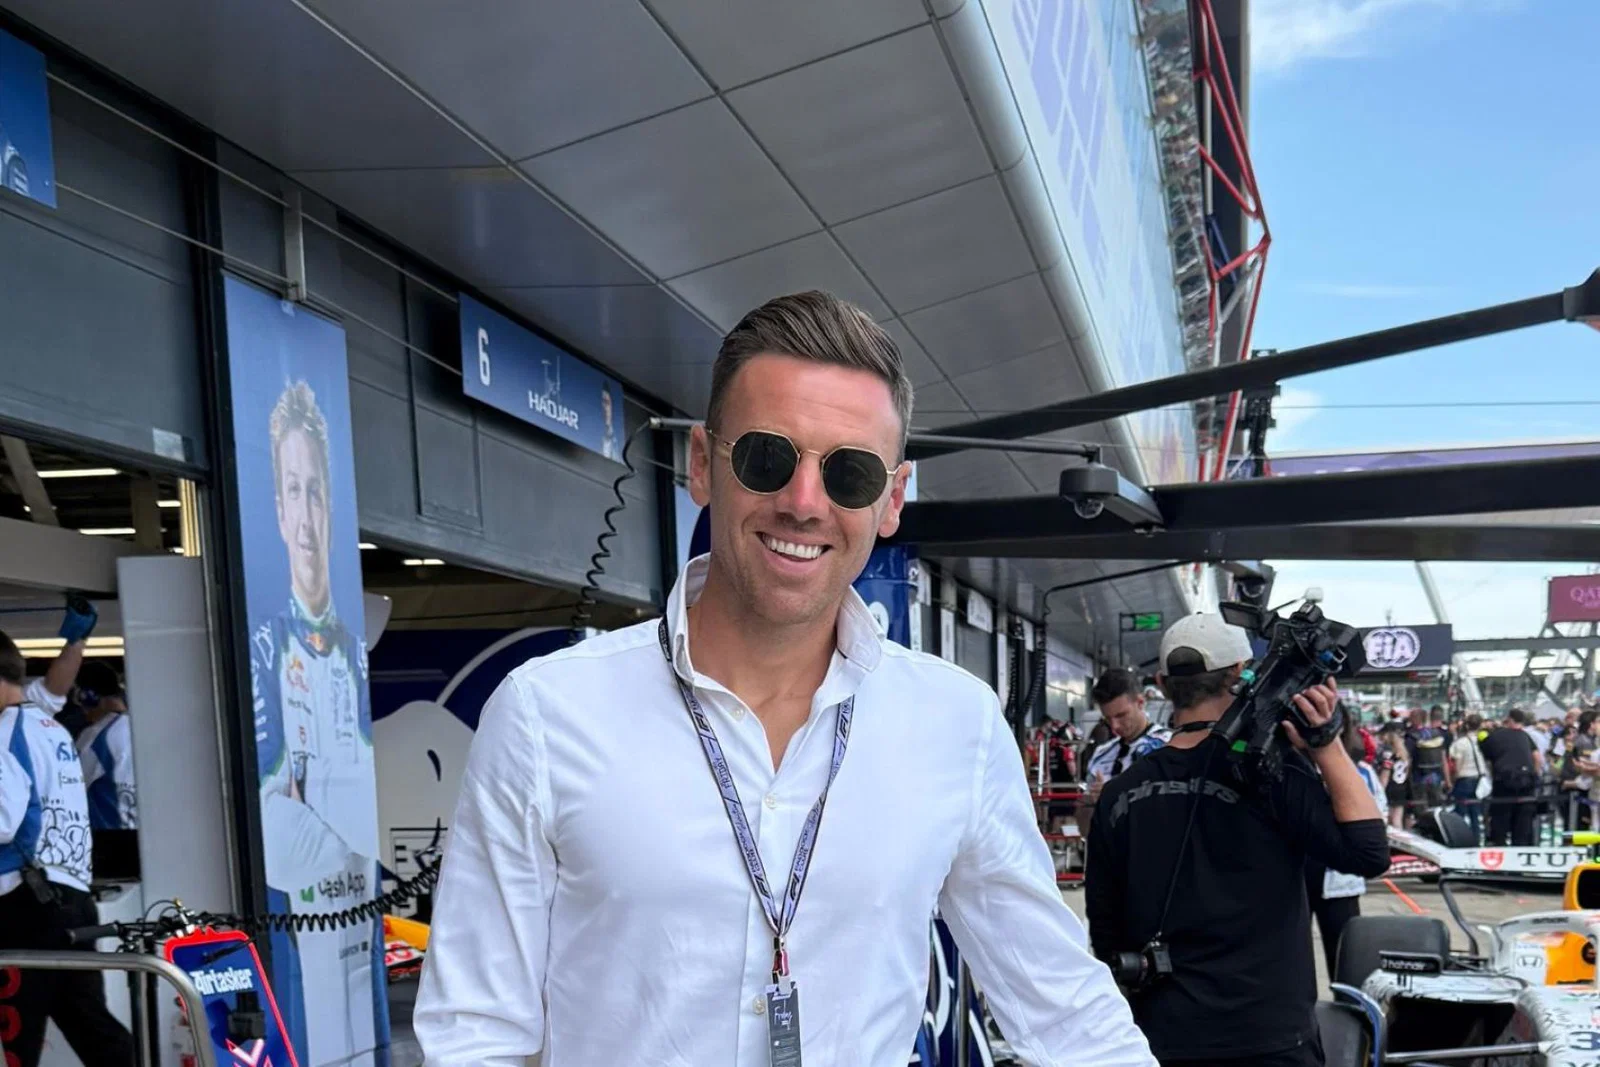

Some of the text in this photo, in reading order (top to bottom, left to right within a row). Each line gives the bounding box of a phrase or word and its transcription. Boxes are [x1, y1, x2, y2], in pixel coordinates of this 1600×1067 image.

[477, 327, 491, 387] 6
[527, 390, 579, 430] HADJAR
[715, 756, 732, 789] FRIDAY
[189, 966, 254, 995] Airtasker
